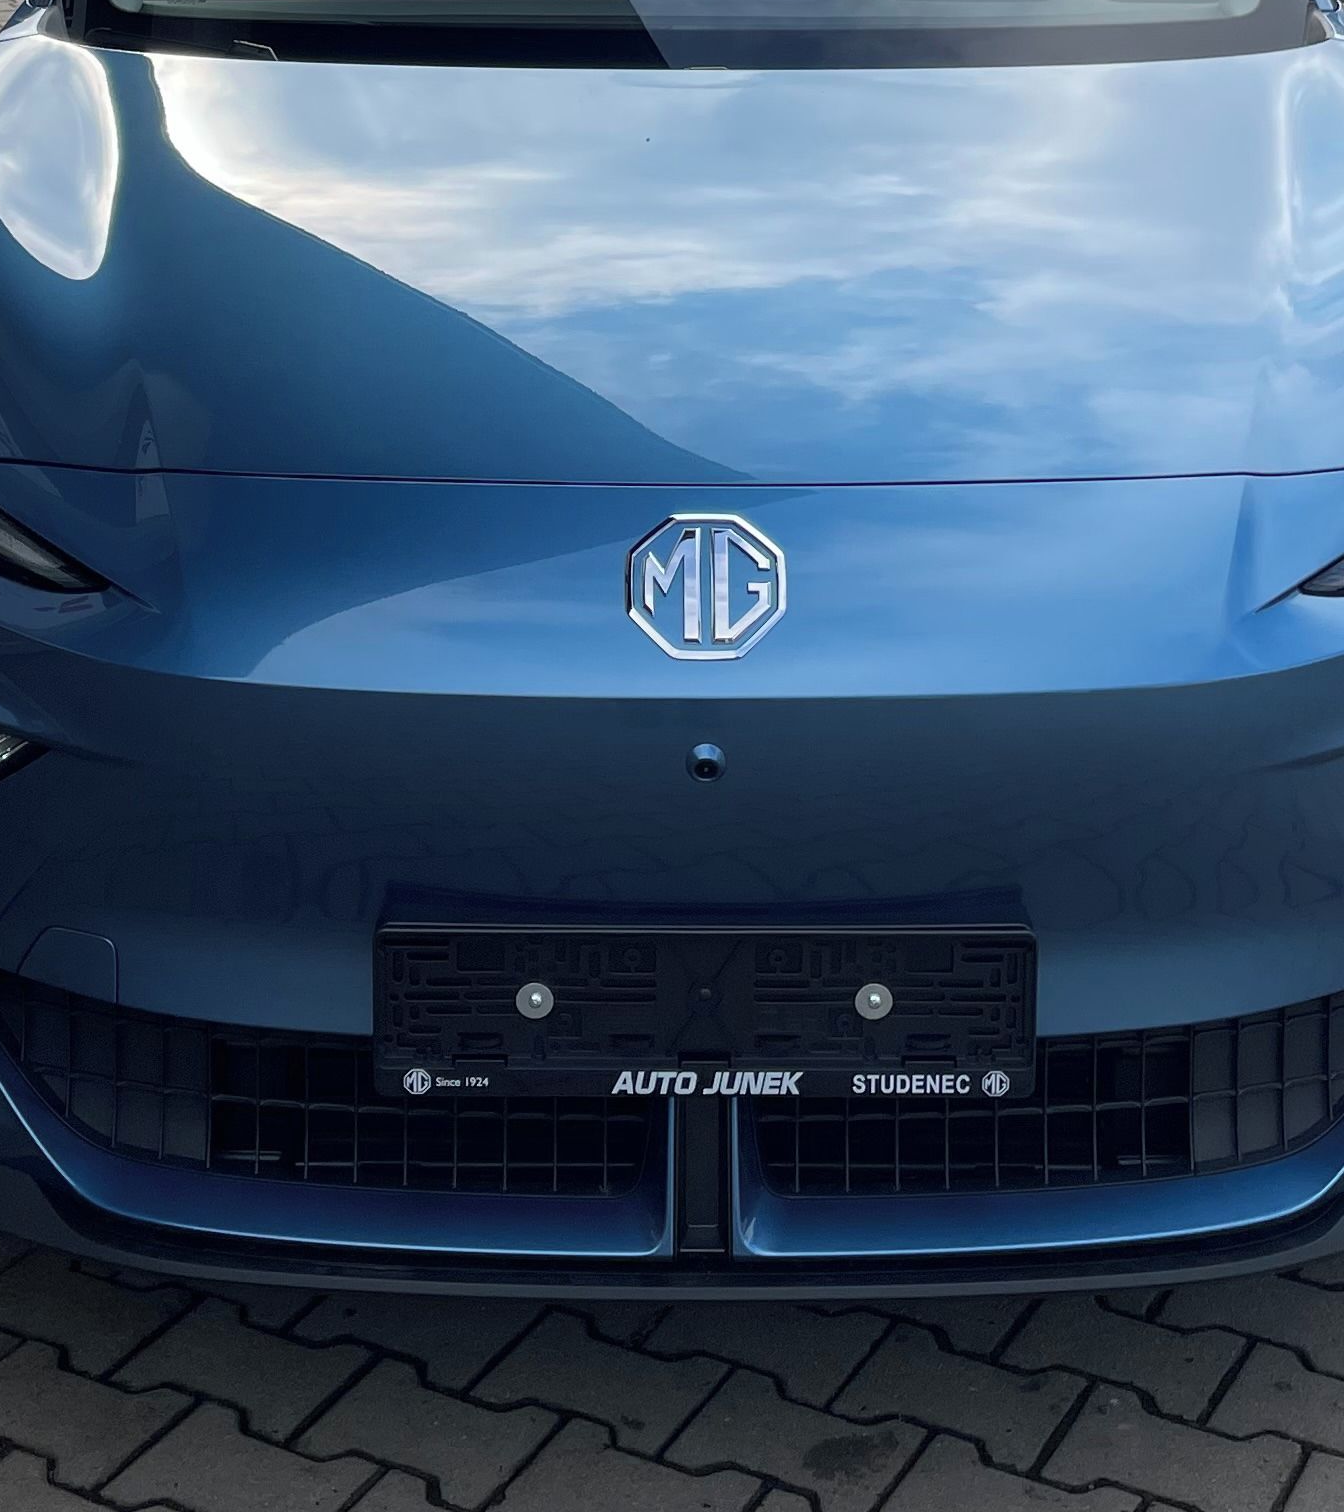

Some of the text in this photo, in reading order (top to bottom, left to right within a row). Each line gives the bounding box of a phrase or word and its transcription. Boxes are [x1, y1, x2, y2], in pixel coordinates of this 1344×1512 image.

[641, 526, 773, 645] MG
[405, 1070, 1009, 1096] MG Since 1924 AUTO JUNEK STUDENEC MG
